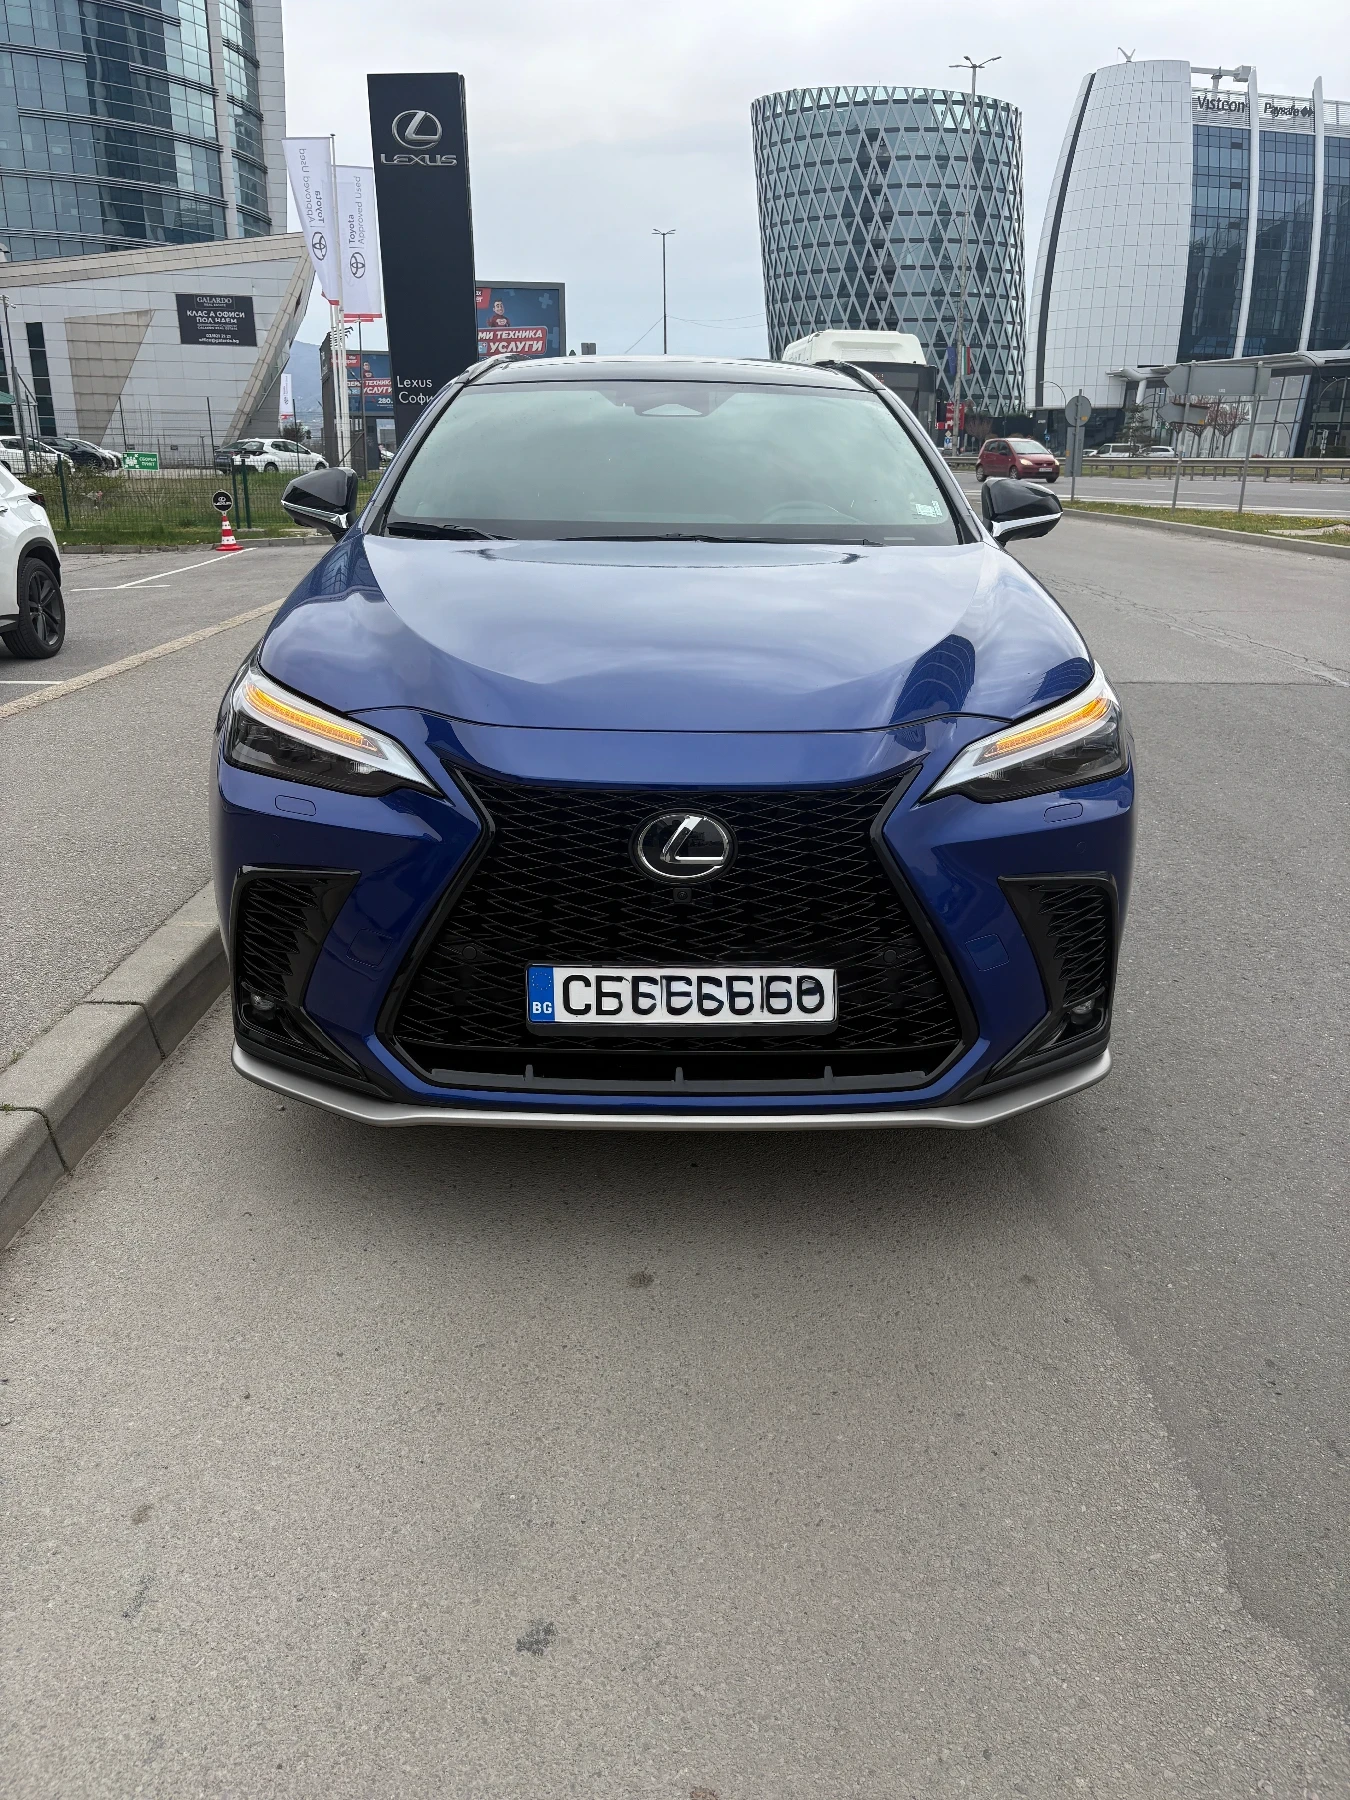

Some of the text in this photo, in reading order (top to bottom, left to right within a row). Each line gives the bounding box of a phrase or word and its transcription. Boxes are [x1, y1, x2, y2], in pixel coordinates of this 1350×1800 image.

[380, 153, 457, 166] LEXUS
[353, 175, 365, 245] Approved Used
[348, 214, 356, 244] Toyota
[495, 330, 543, 339] ТЕХНИКА
[489, 341, 543, 353] УСЛУГИ
[397, 375, 433, 388] Lexus
[398, 391, 434, 406] Софи
[532, 1001, 552, 1014] BG
